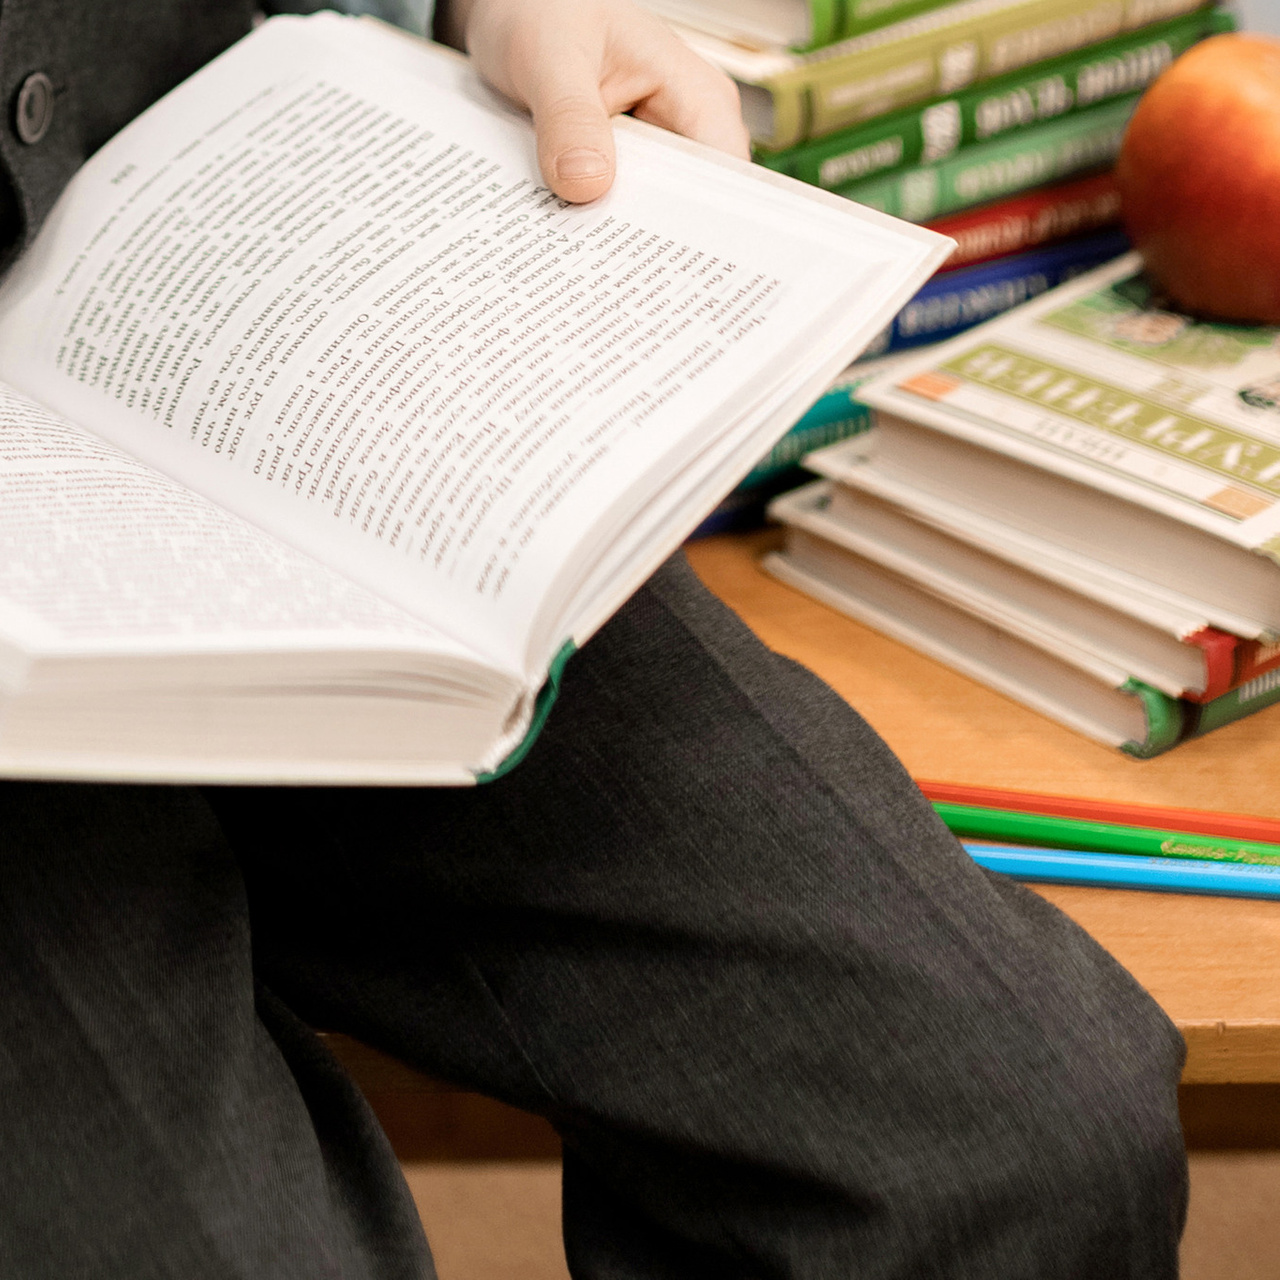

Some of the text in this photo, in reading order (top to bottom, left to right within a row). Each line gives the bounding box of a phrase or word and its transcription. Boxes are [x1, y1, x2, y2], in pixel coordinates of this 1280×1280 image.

[492, 213, 529, 236] Одни
[505, 225, 531, 244] уже
[533, 211, 554, 226] мы
[585, 215, 614, 238] день
[440, 259, 460, 273] же
[446, 246, 502, 283] одолели.
[462, 247, 478, 257] те
[500, 242, 556, 283] русский?
[562, 239, 585, 255] оба
[590, 228, 645, 270] какие-то
[520, 256, 560, 284] языка
[385, 275, 436, 315] каждый
[430, 295, 481, 333] спросил
[470, 295, 506, 320] через
[514, 274, 584, 324] противные
[317, 313, 369, 363] Онегина
[356, 319, 382, 340] год.
[364, 298, 429, 355] сочинения
[438, 320, 468, 345] день
[294, 228, 556, 495] Русский? Это пустое. Правописание по Гро-
[333, 222, 630, 517] стике, потом кусочек из уставов. Затем через
[336, 359, 362, 387] ведь
[376, 335, 431, 387] Ромашов
[444, 327, 509, 378] формулы,
[163, 357, 202, 428] Ромочка!
[360, 389, 376, 406] из
[361, 233, 660, 532] наук вот артиллерия мне, правда, не дается: все
[375, 239, 674, 537] проходим кусок из математики, кусок из военных
[376, 348, 437, 412] география
[274, 384, 304, 425] связи
[292, 392, 335, 457] известно
[389, 386, 441, 445] особенно
[253, 448, 266, 475] его
[307, 408, 361, 498] вежливости.
[321, 427, 366, 502] историей.
[349, 469, 378, 523] балли-
